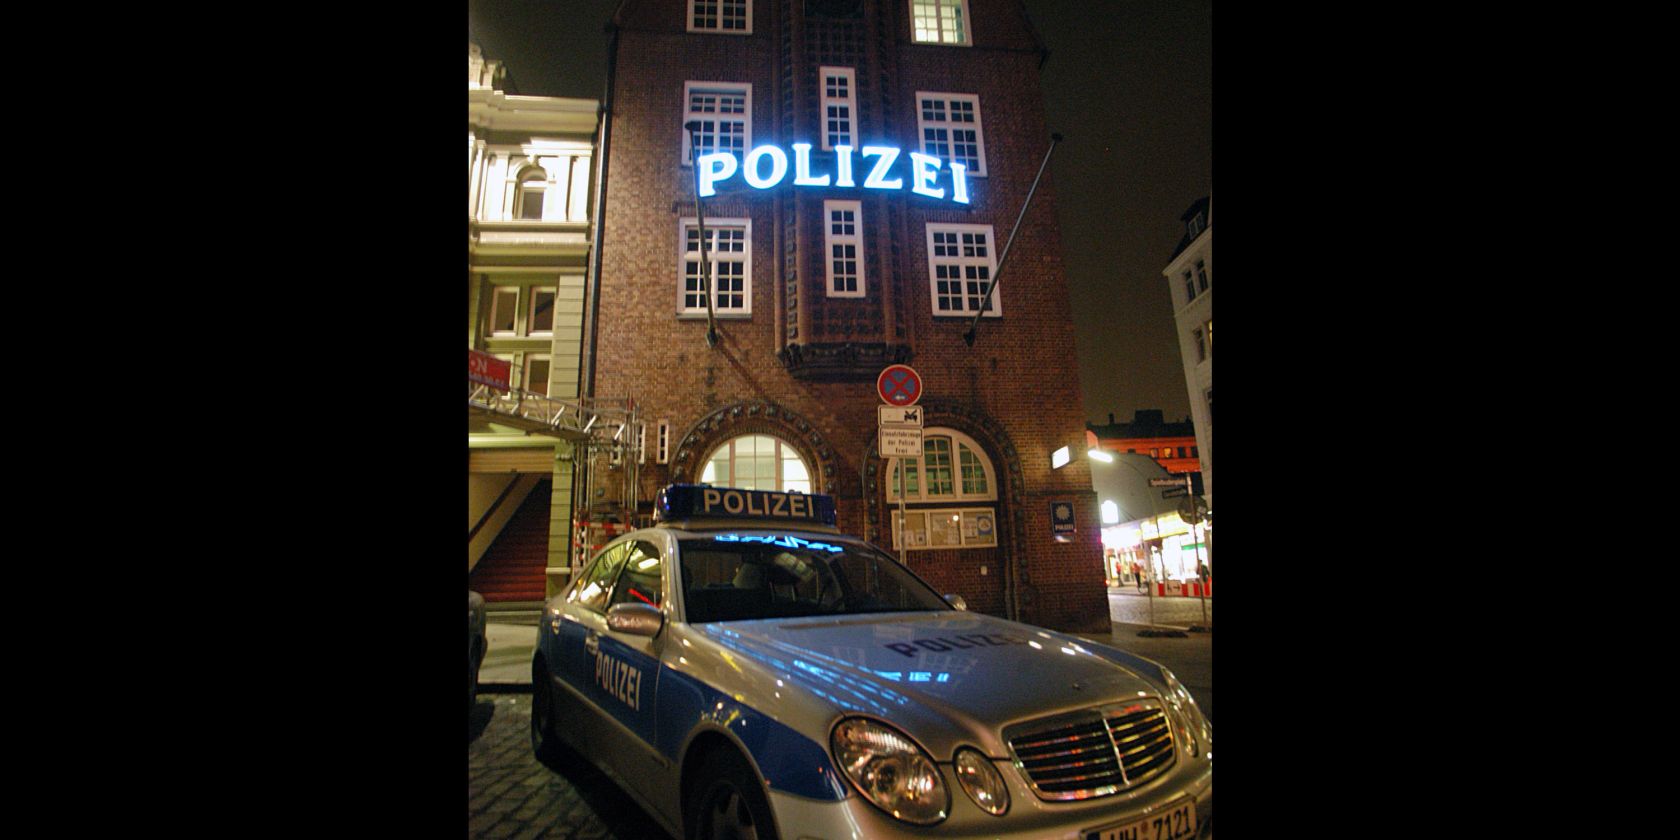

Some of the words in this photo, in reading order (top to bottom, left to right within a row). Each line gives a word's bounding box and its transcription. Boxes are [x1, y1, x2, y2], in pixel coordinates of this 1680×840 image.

[698, 143, 970, 204] POLIZEI
[703, 489, 814, 518] POLIZEI
[595, 650, 642, 712] POLIZEI
[1153, 805, 1192, 840] 7121
